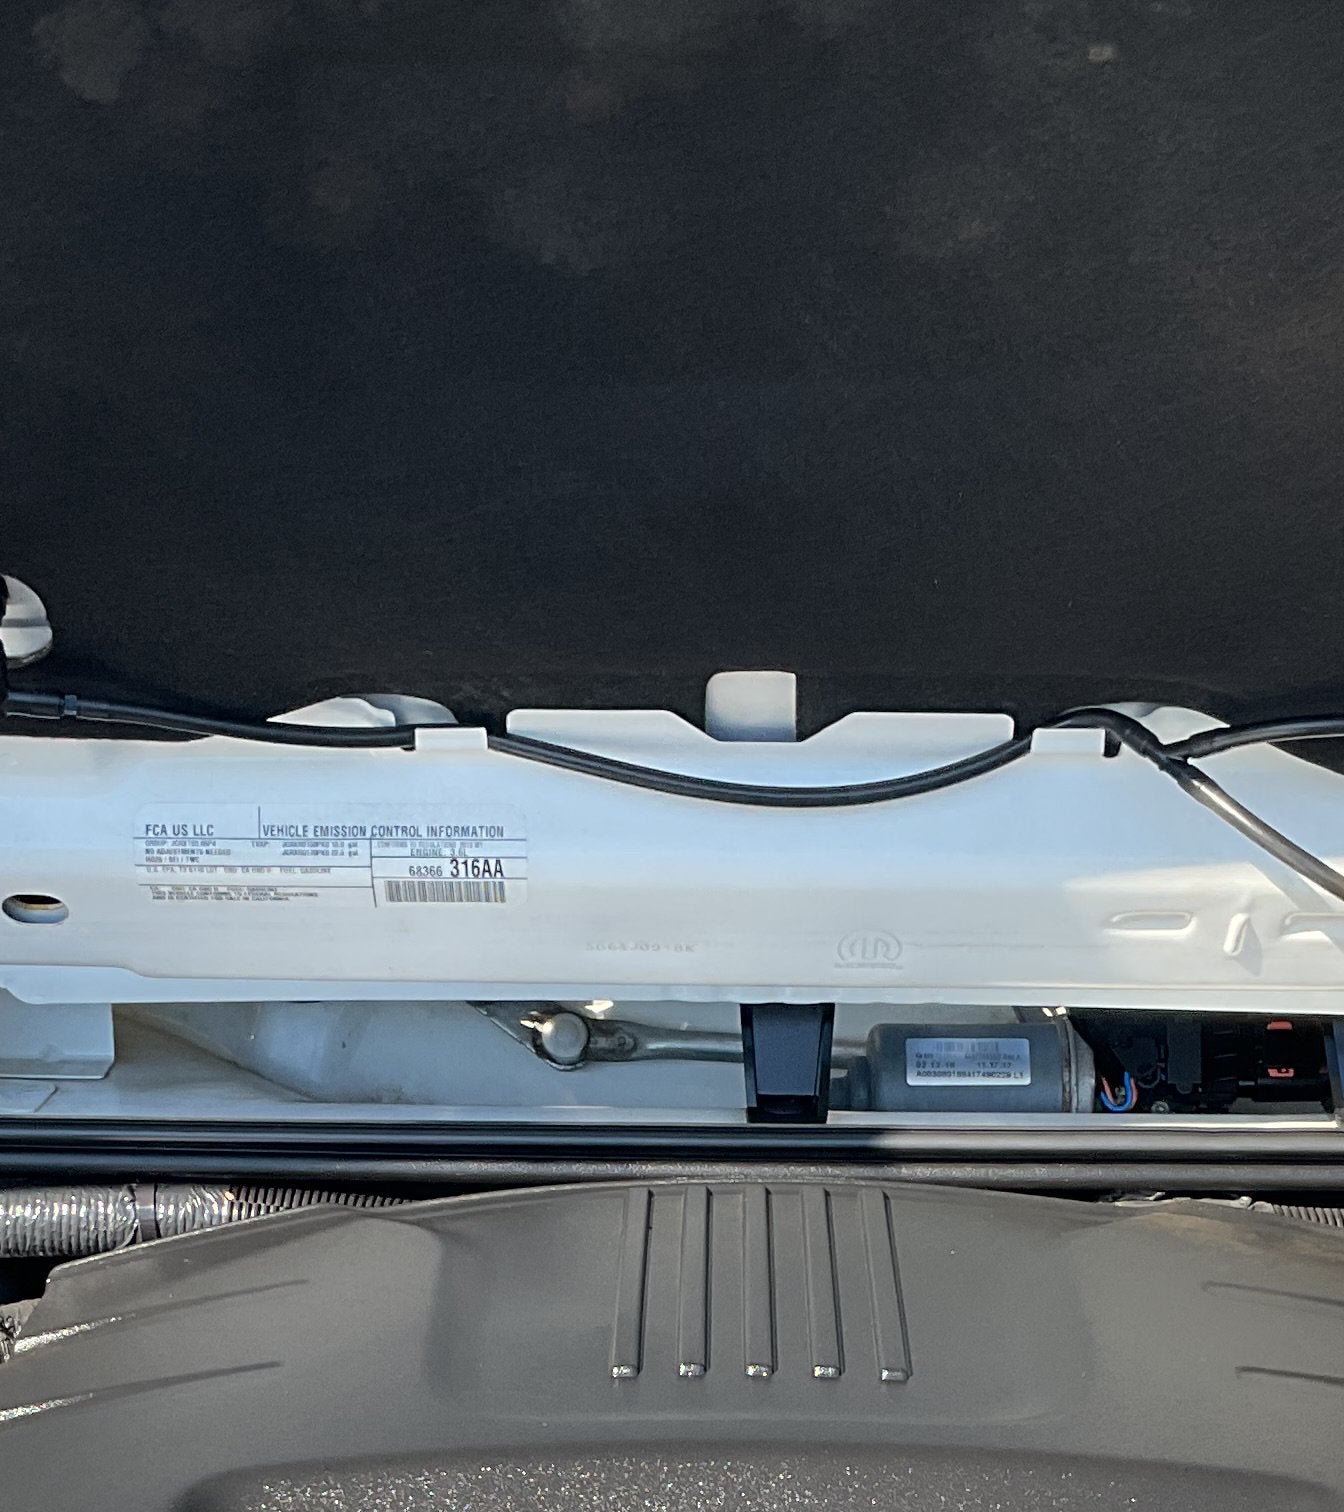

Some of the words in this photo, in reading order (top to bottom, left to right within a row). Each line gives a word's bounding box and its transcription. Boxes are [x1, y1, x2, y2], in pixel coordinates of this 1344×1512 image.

[145, 823, 168, 837] FCA
[172, 823, 190, 837] US
[193, 824, 214, 837] LLC
[262, 824, 309, 838] VEHICLE
[313, 825, 367, 838] EMISSION
[371, 825, 423, 839] CONTROL
[427, 825, 505, 839] INFORMATION
[408, 865, 443, 878] 68366
[449, 858, 505, 879] 316AA
